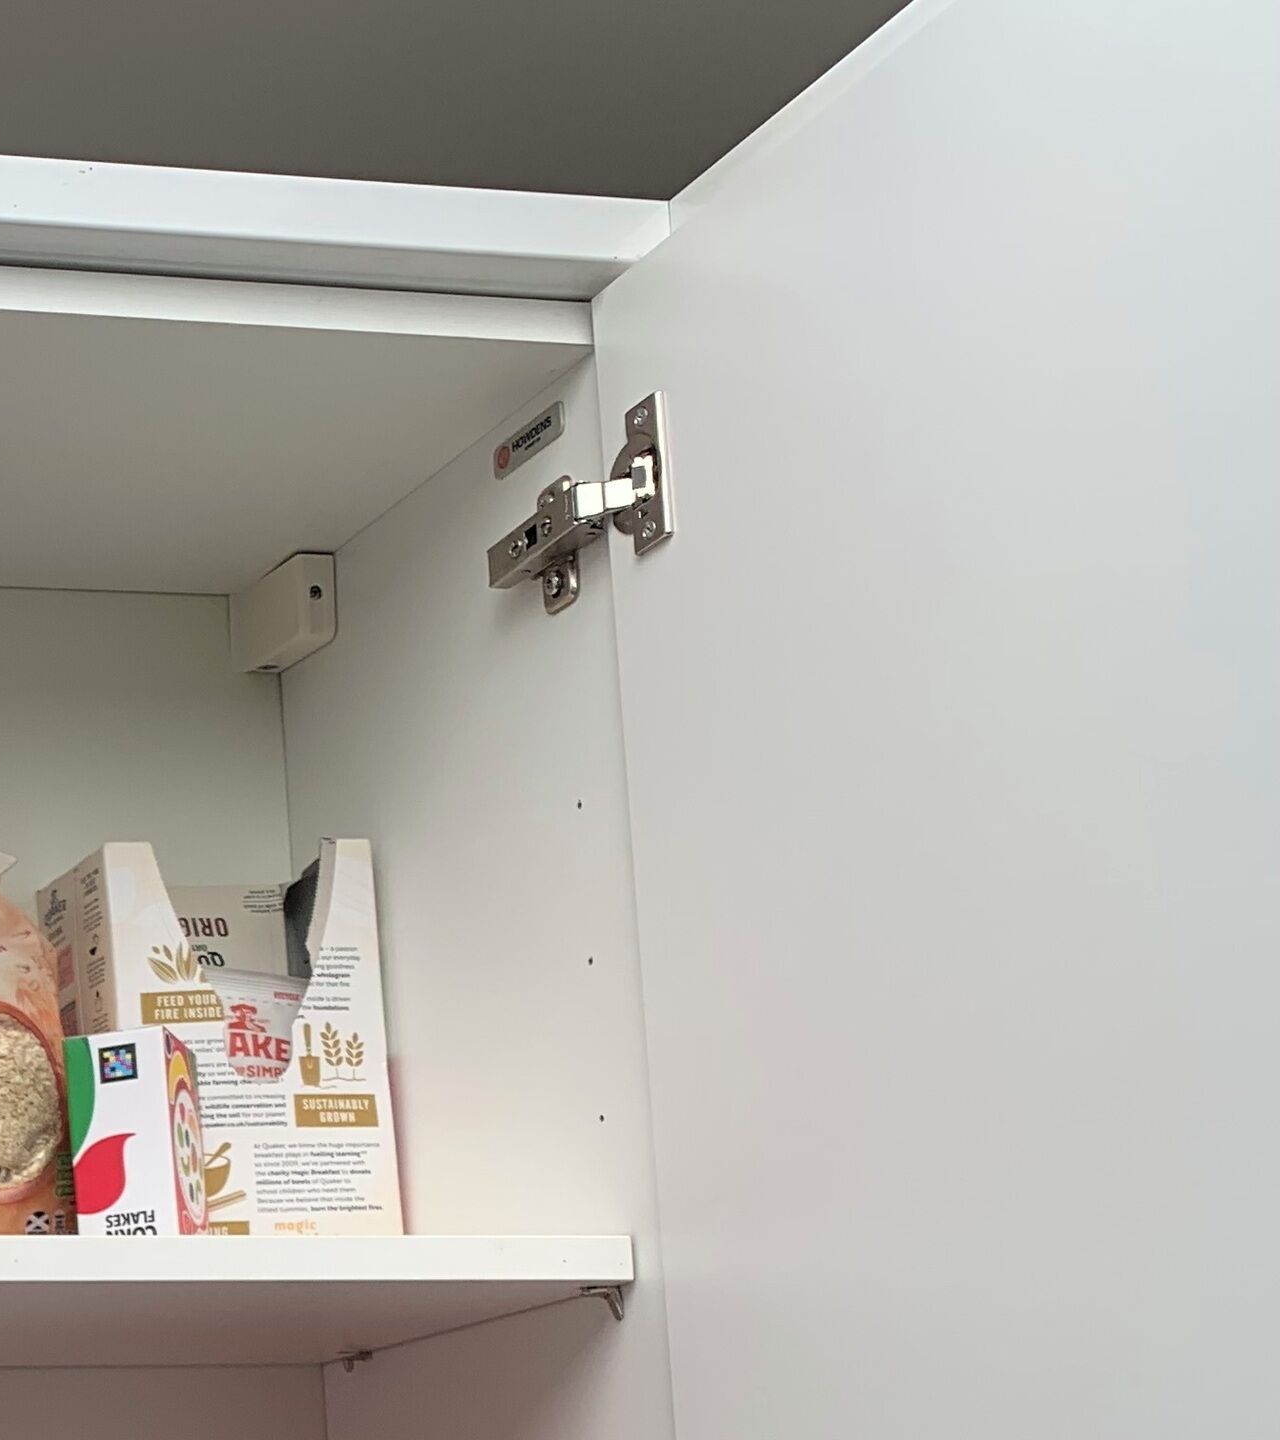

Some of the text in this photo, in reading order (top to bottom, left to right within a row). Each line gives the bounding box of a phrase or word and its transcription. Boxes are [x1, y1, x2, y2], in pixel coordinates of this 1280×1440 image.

[512, 416, 552, 453] HOWDENS
[156, 994, 218, 1008] FEED YOUR
[154, 1006, 223, 1020] FIRE INSIDE
[302, 1098, 369, 1111] SUSTAINABLY
[320, 1112, 356, 1123] GROWN
[105, 1210, 155, 1228] FLAKES
